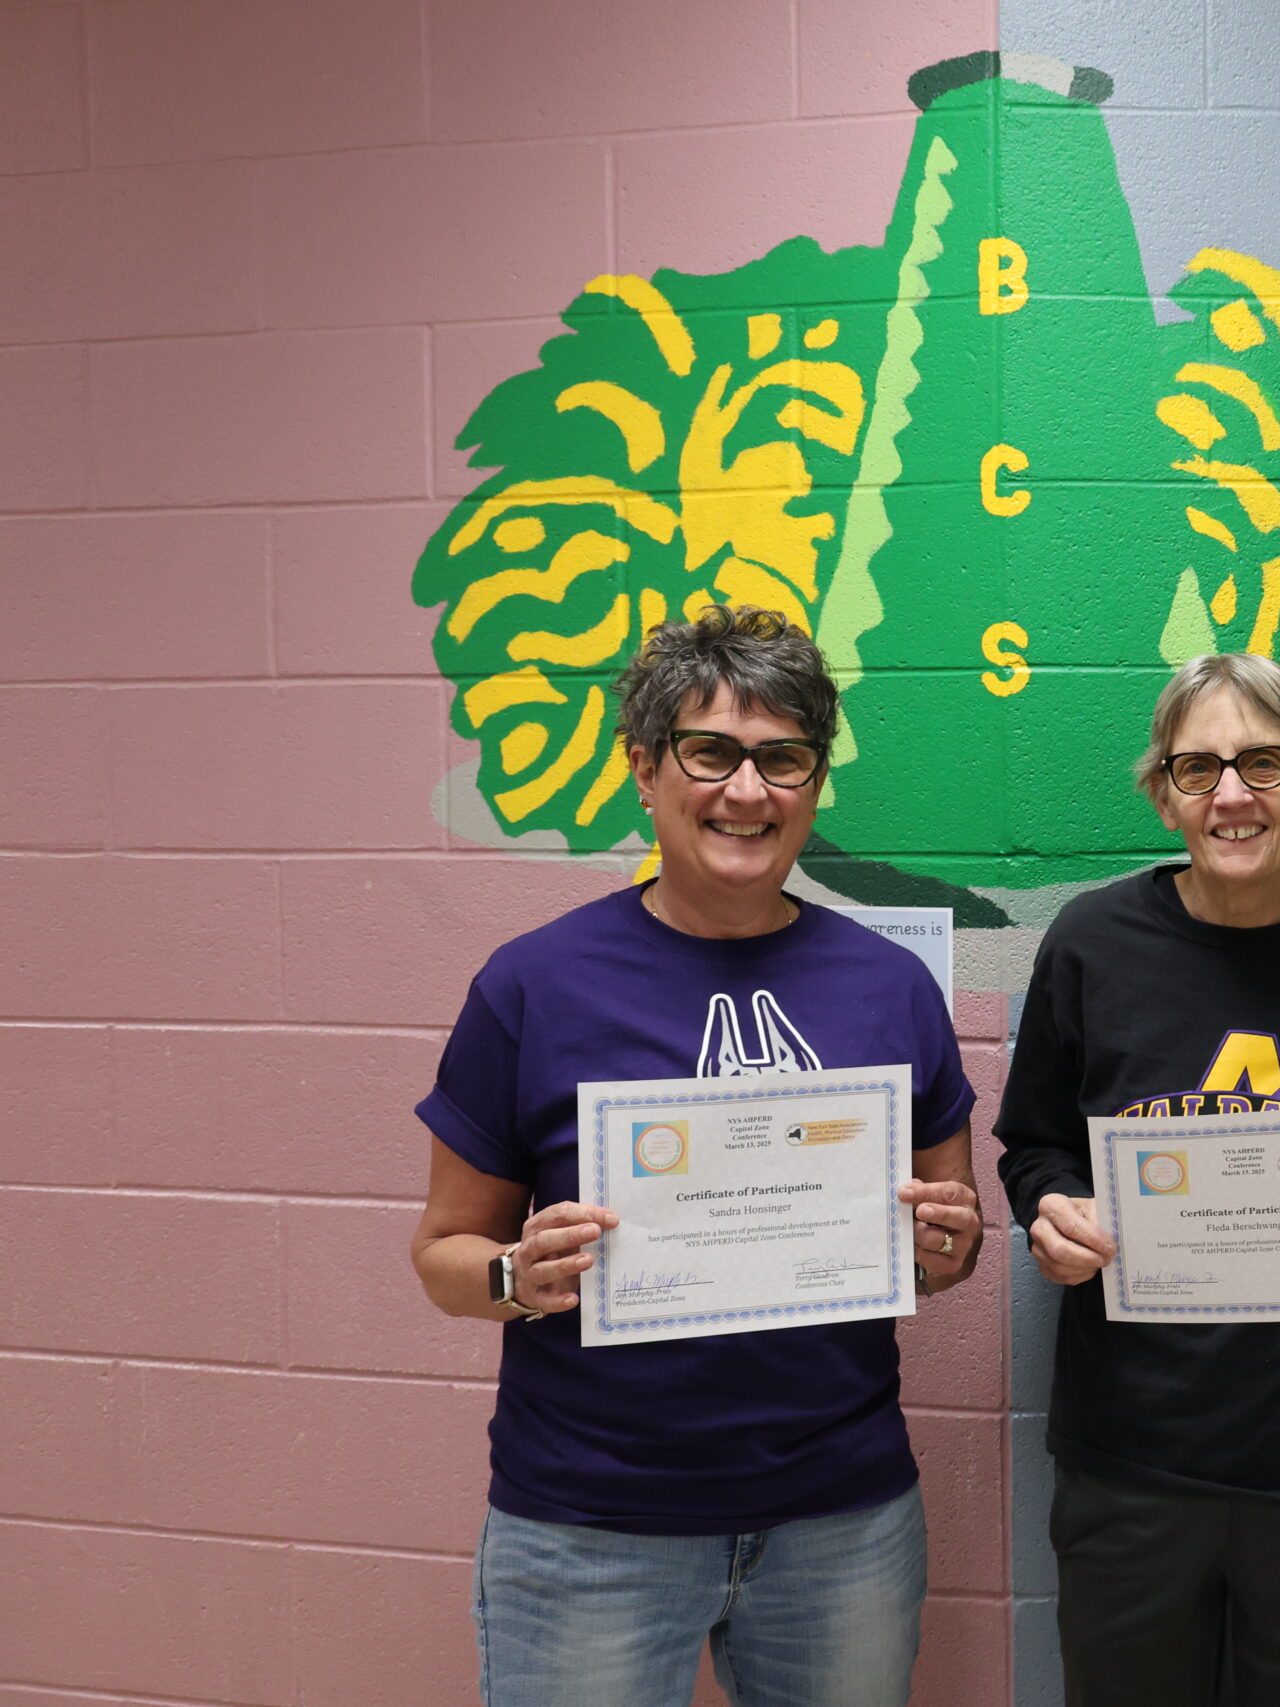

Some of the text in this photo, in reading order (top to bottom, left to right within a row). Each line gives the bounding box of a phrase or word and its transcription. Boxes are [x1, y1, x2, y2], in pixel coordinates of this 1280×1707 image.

[862, 922, 943, 936] areness is
[743, 1115, 772, 1123] AHPERD
[730, 1125, 752, 1133] Capital
[732, 1133, 767, 1141] Conference
[746, 1141, 756, 1149] 13,
[757, 1140, 771, 1148] 2025
[676, 1182, 822, 1202] Certificate of Participation
[708, 1202, 792, 1218] Sandra Honsinger
[1180, 1208, 1233, 1218] Certificate
[1235, 1207, 1248, 1215] of
[648, 1235, 660, 1243] has
[661, 1231, 702, 1243] participated
[718, 1228, 737, 1237] hours
[738, 1227, 746, 1235] of
[747, 1223, 787, 1235] professional
[788, 1220, 830, 1230] development
[685, 1230, 815, 1248] NYS AHPERD Capital Zone Conference
